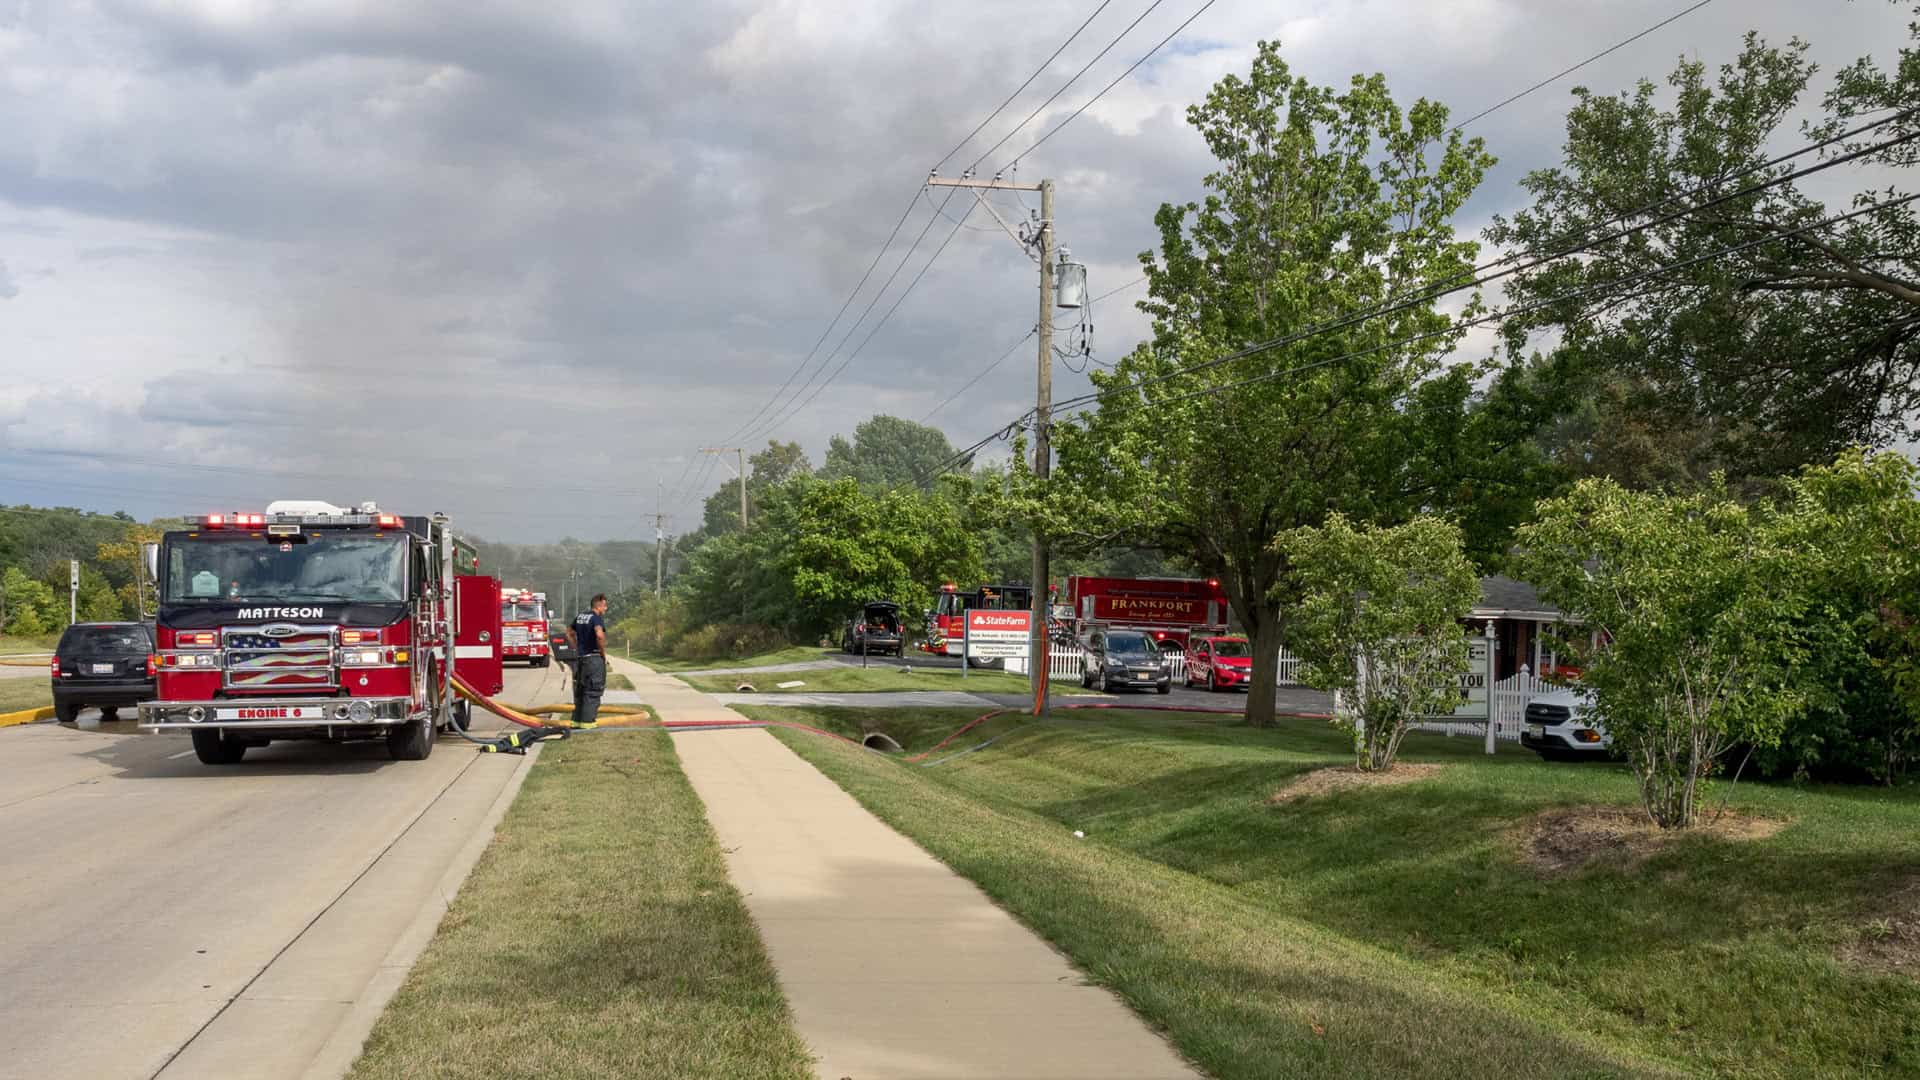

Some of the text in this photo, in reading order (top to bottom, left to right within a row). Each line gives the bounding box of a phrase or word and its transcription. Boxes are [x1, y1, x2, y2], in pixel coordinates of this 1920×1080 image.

[1111, 599, 1192, 613] FRANKFORT
[237, 607, 323, 619] MATTESON
[985, 615, 1026, 625] StateFarm
[1459, 674, 1484, 687] YOU
[238, 708, 302, 718] ENGINE 6
